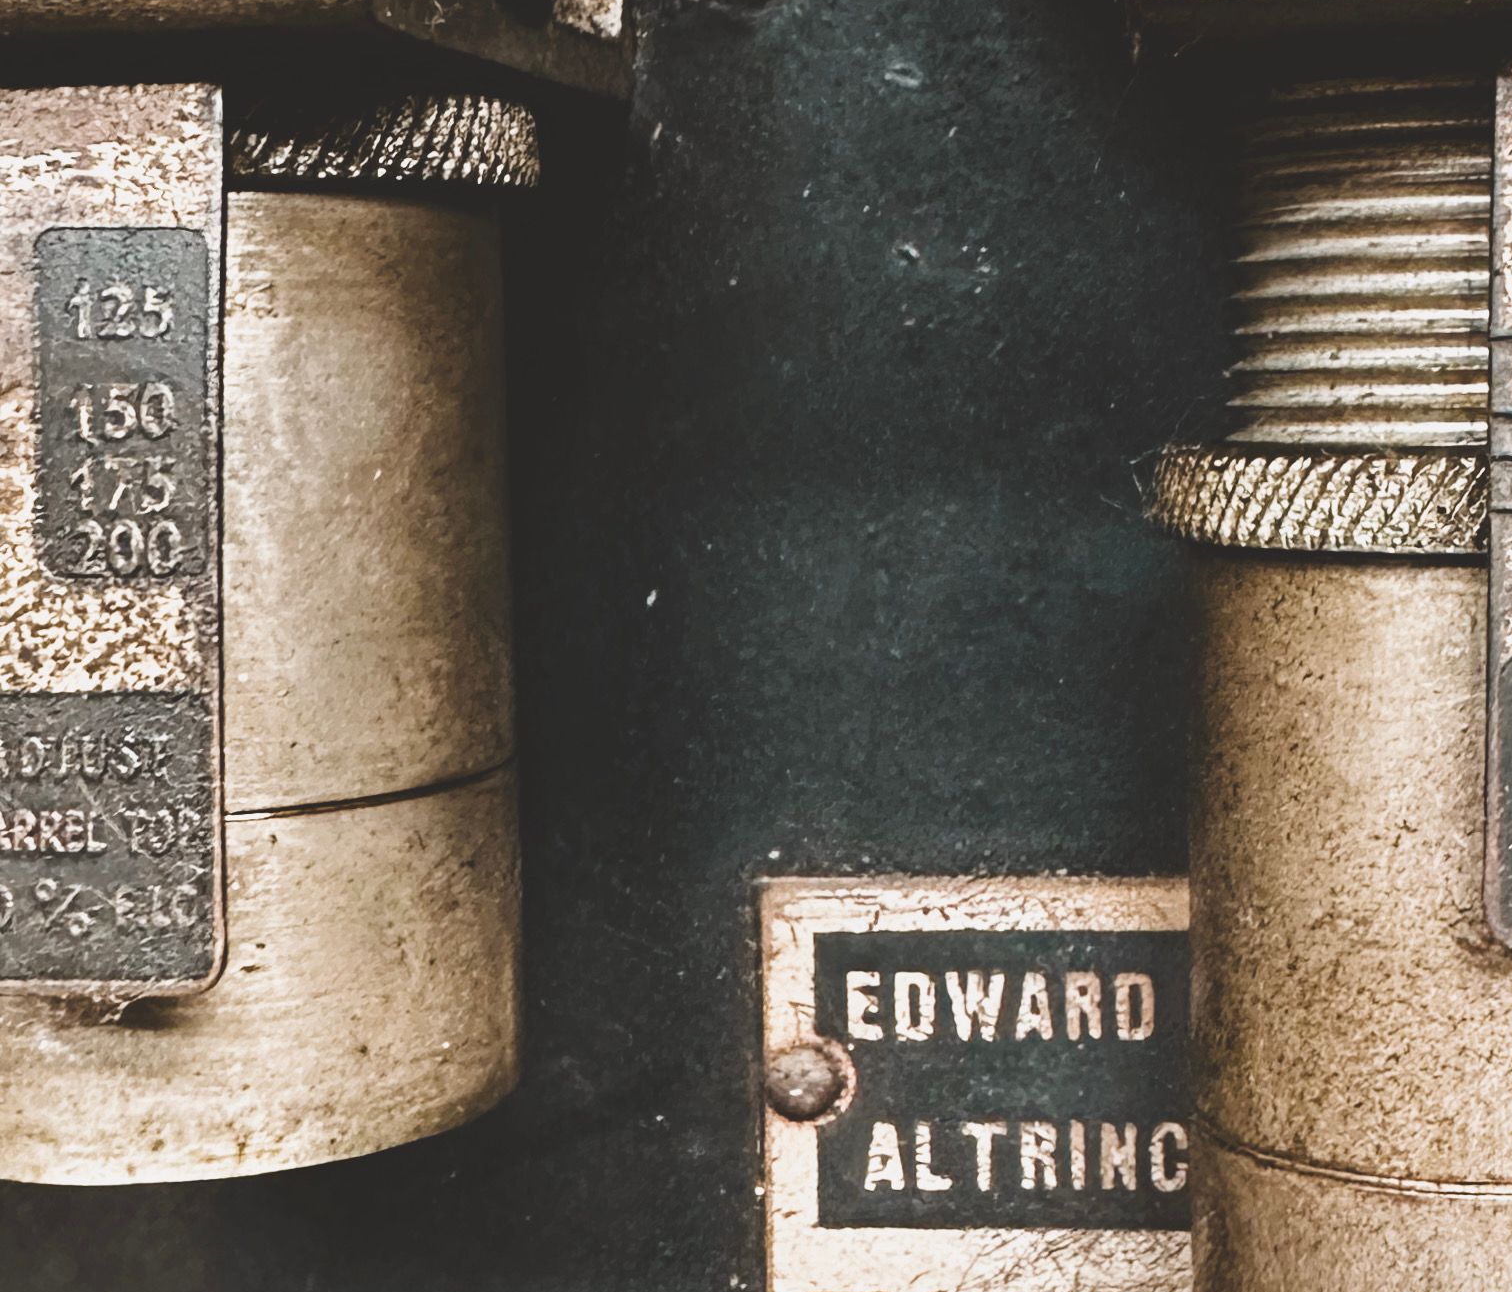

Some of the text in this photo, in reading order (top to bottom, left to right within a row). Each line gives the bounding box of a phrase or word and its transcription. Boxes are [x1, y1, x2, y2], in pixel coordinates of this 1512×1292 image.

[68, 280, 174, 339] 125
[69, 382, 176, 444] 150
[70, 457, 176, 514] 175
[72, 519, 183, 574] 200
[846, 969, 1156, 1042] EDWARD
